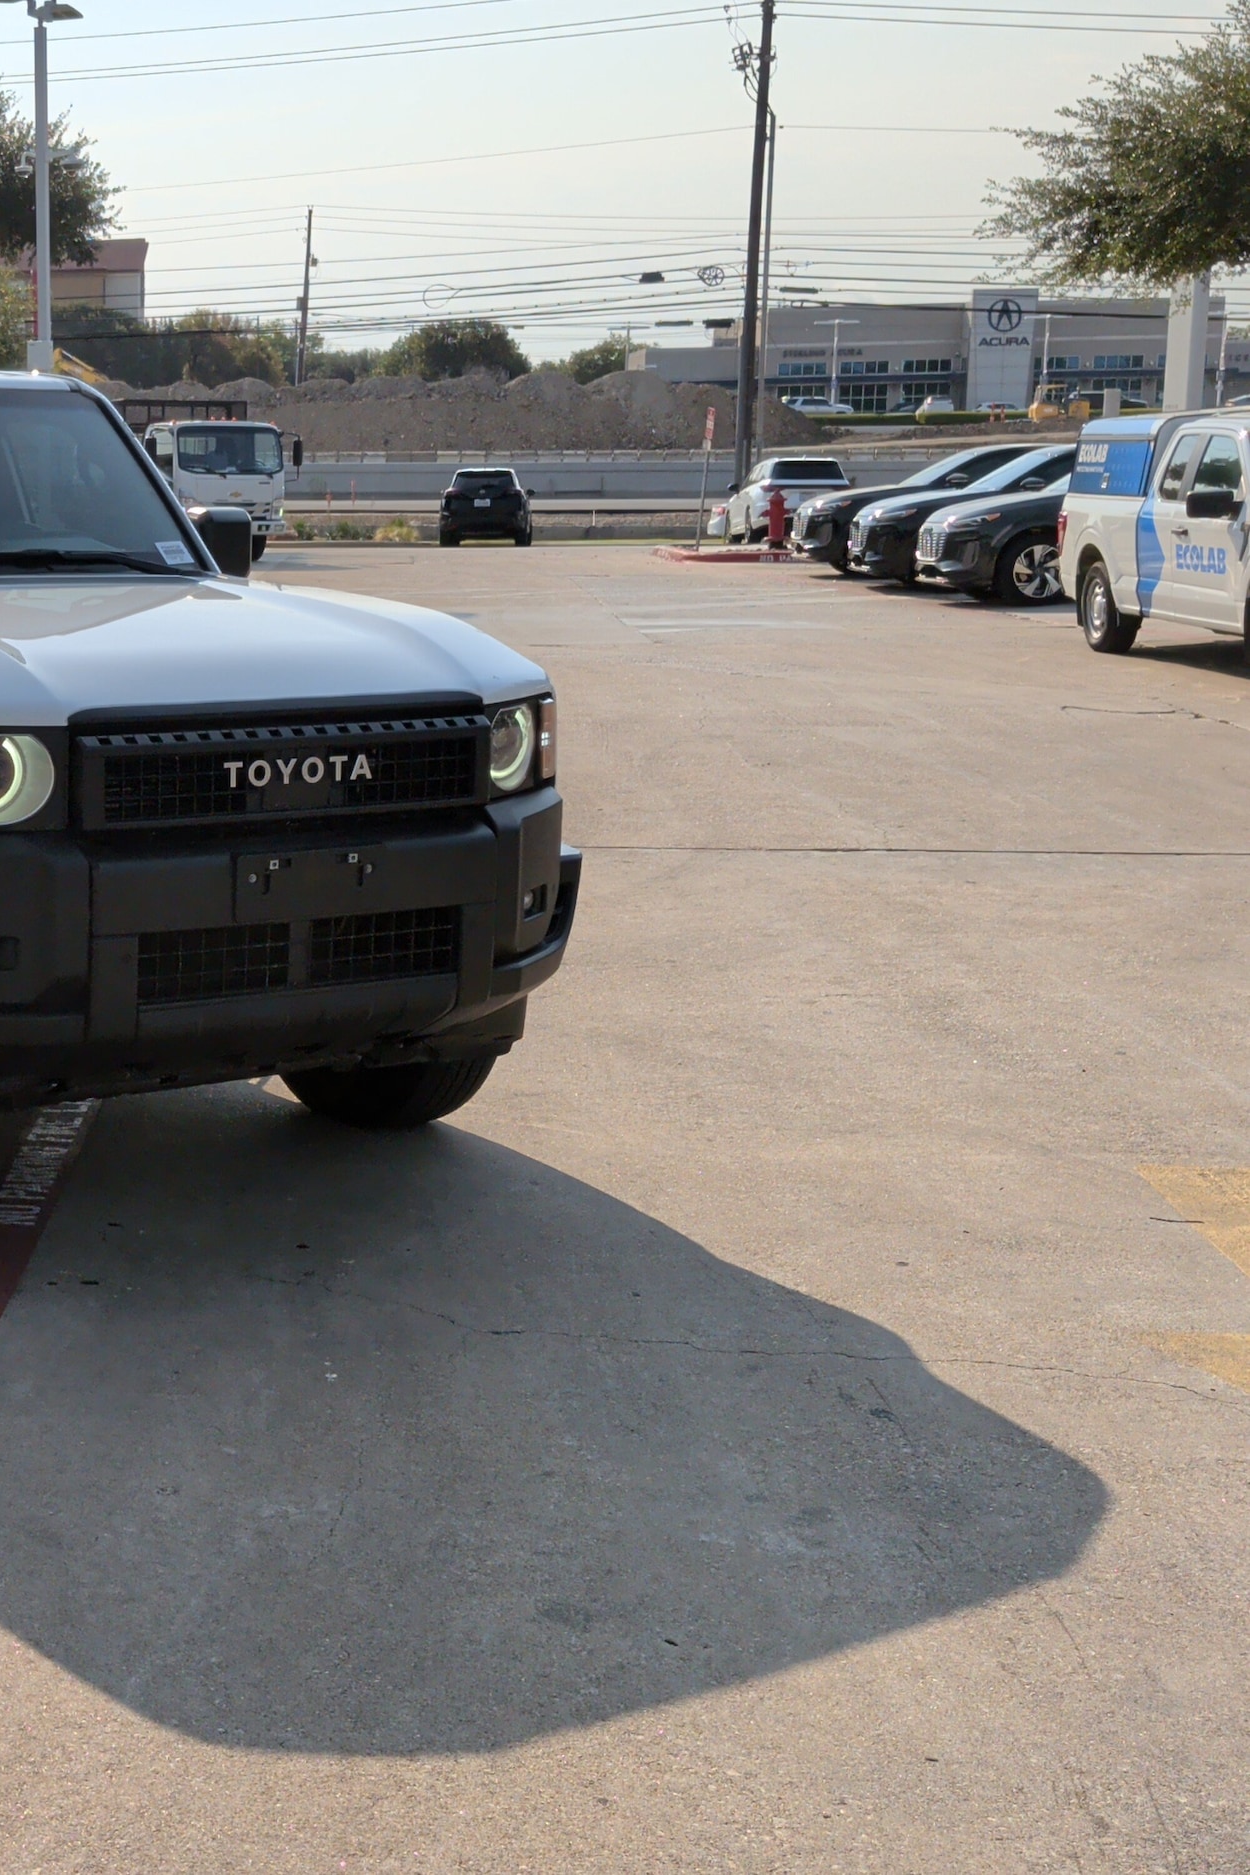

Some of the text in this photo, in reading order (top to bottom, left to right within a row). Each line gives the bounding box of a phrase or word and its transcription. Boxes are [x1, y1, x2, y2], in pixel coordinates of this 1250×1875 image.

[978, 336, 1030, 347] ACURA
[1078, 443, 1109, 463] ECOLAB
[1175, 544, 1227, 575] ECOLAB
[223, 753, 373, 788] TOYOTA
